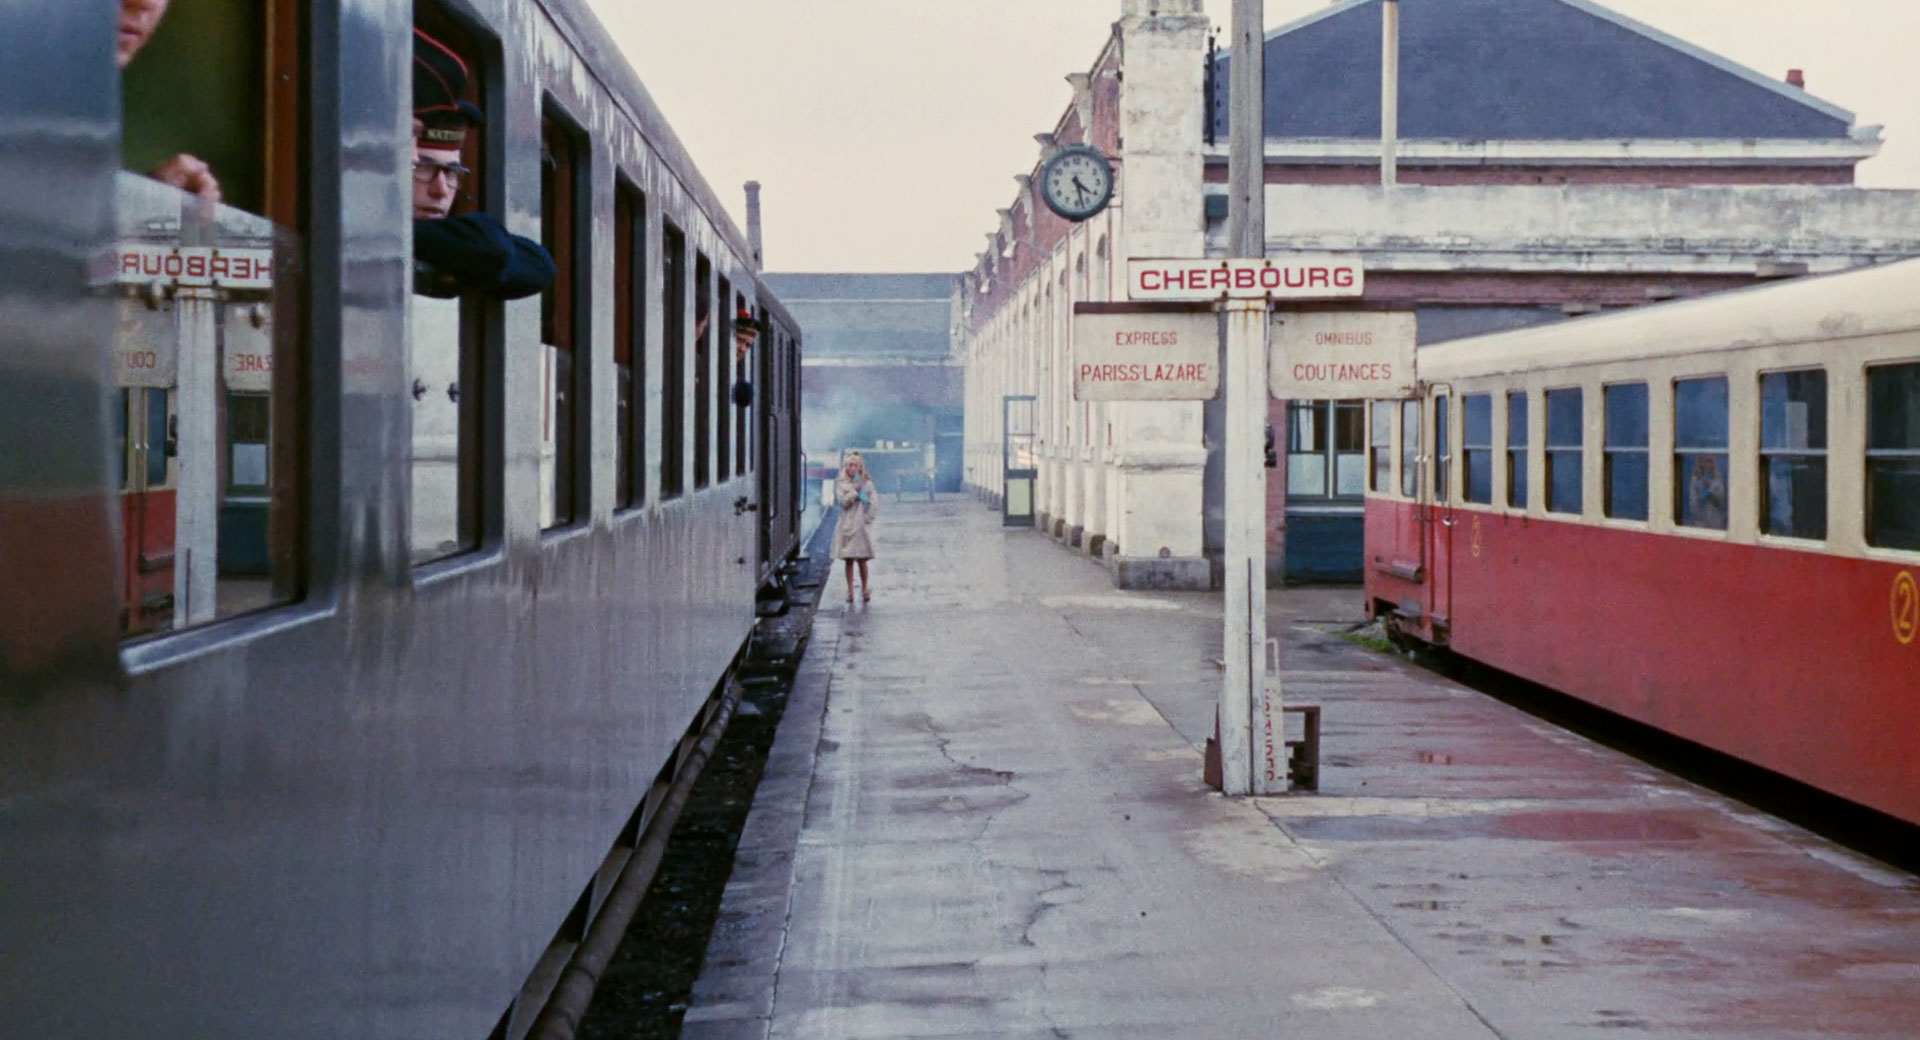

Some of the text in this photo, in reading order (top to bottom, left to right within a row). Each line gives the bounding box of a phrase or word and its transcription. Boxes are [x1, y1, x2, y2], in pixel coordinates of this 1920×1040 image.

[1140, 267, 1354, 290] CHERBOURG
[1115, 331, 1178, 345] EXPRESS
[1315, 331, 1373, 345] OMNIBUS
[1293, 363, 1392, 381] COUTANCES
